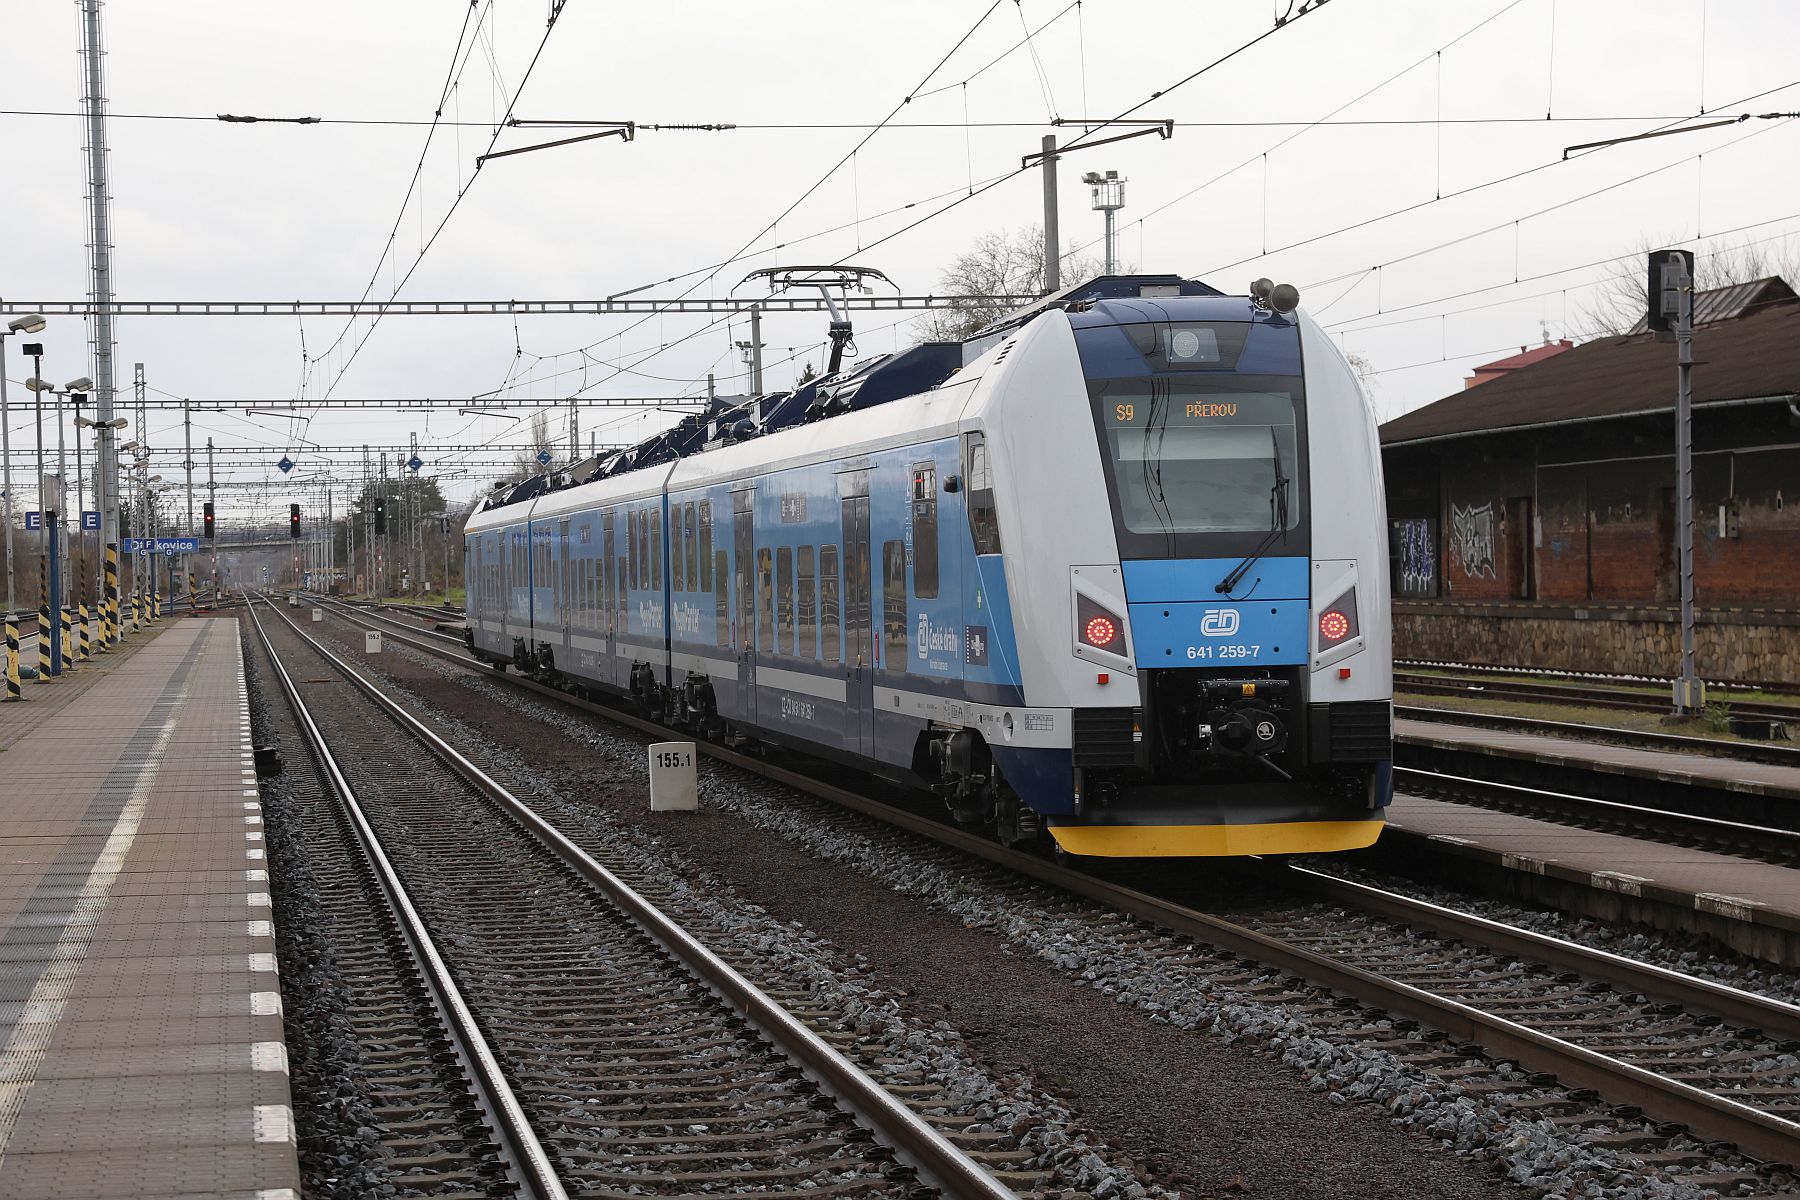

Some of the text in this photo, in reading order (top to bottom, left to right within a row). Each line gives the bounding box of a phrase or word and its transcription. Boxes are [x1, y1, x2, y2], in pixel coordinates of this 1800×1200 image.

[1116, 401, 1237, 420] S9 PŘEROV
[30, 514, 40, 527] E
[86, 514, 97, 527] E
[130, 540, 193, 550] Otkovice
[145, 540, 152, 549] F
[1187, 645, 1260, 659] 641 259-7
[657, 753, 691, 768] 155.1
